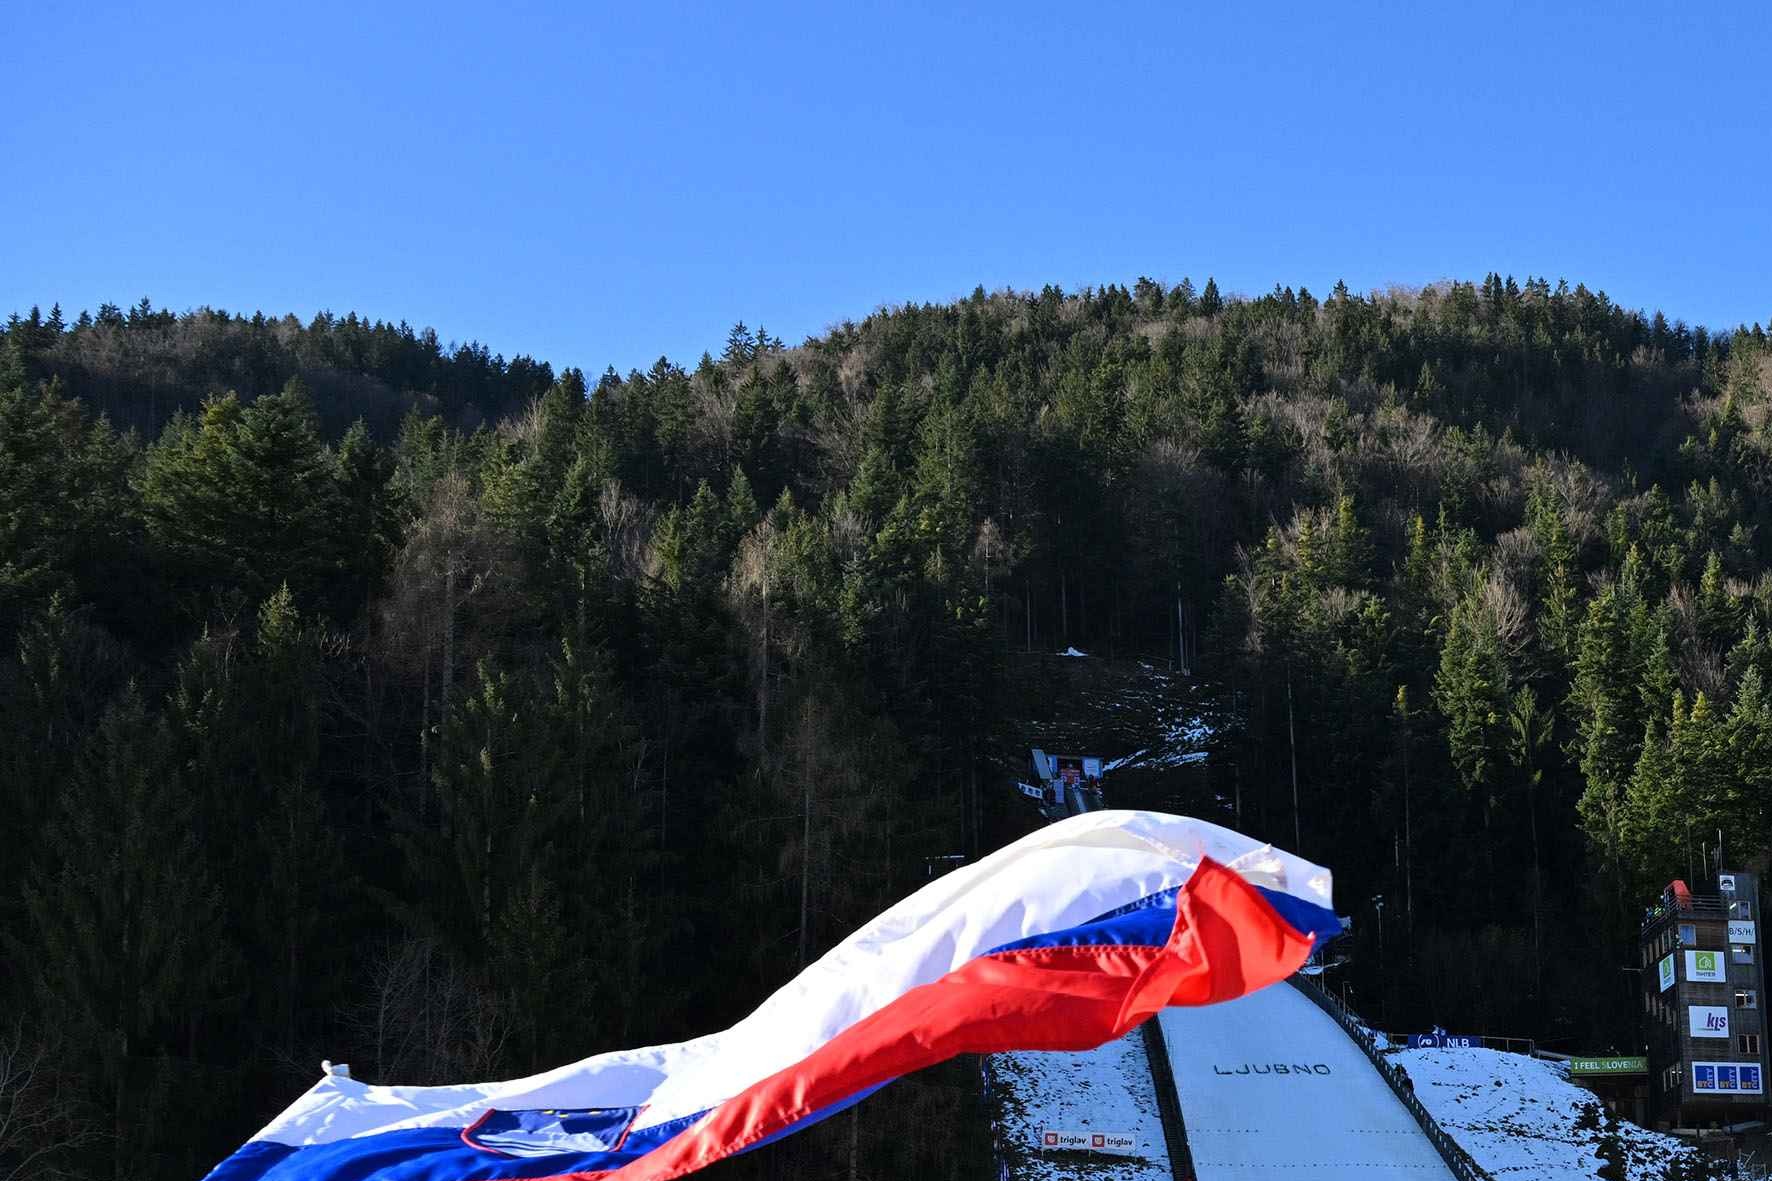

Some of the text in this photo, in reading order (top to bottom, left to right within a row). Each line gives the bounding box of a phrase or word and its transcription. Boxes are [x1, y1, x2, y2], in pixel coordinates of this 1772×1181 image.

[1447, 1037, 1470, 1048] NLB
[1214, 1064, 1331, 1075] LJUBNO
[1580, 1061, 1600, 1069] FEEL
[1060, 1136, 1133, 1147] triglav triglav
